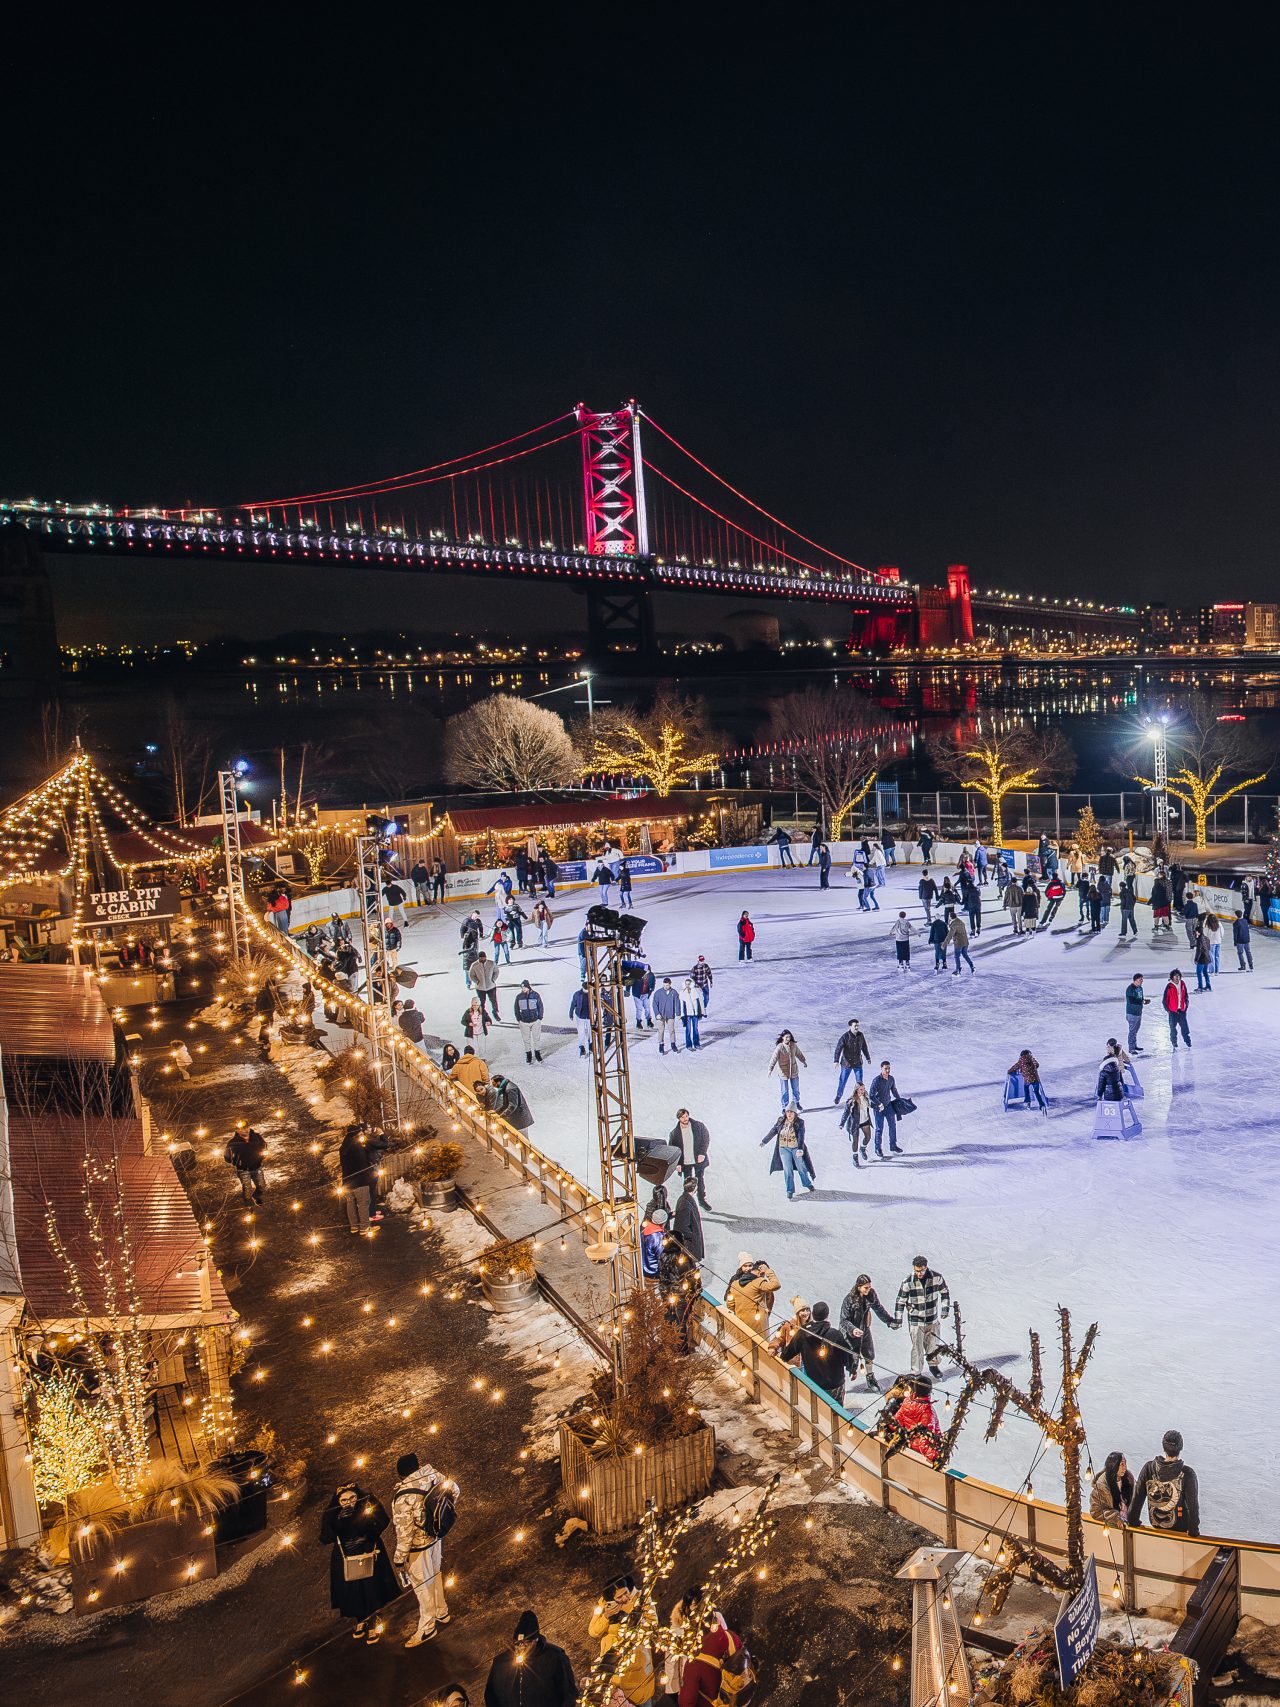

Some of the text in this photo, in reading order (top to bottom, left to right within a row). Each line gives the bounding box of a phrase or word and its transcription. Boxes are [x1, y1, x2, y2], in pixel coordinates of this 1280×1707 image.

[90, 887, 161, 905] FIRE PIT
[108, 913, 130, 921] CHECK
[1104, 1108, 1116, 1116] 03
[1067, 1629, 1080, 1646] No
[1071, 1649, 1090, 1674] This
